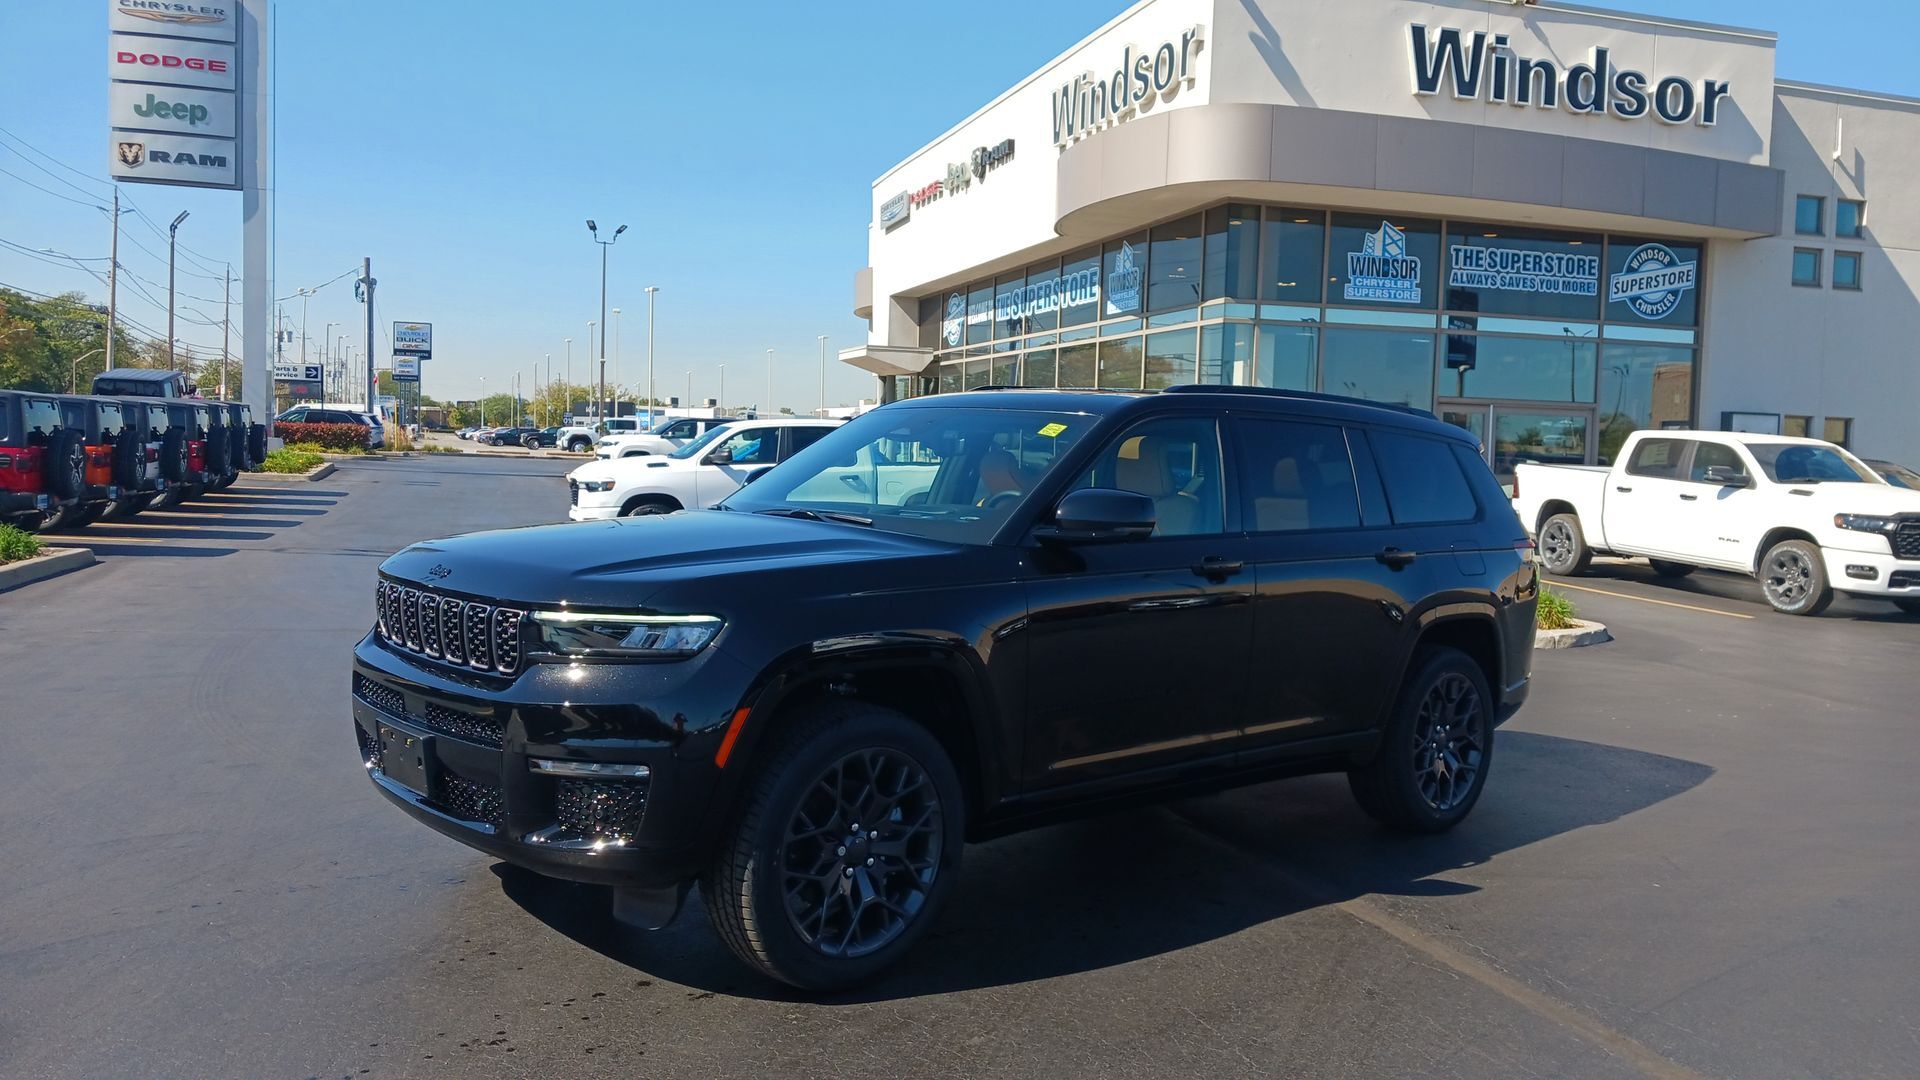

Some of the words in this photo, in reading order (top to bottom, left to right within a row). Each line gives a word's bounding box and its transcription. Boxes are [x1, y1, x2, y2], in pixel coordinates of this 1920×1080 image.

[119, 0, 225, 15] CHRYSLER
[117, 51, 227, 73] DODGE
[1051, 24, 1205, 147] Windsor
[1408, 23, 1731, 127] Windsor
[133, 93, 208, 125] Jeep
[149, 150, 227, 168] RAM
[1350, 255, 1418, 280] WINDSOR
[1452, 248, 1484, 268] THE
[1487, 250, 1597, 277] SUPERSTORE
[1630, 249, 1670, 269] WINDSOR
[1355, 278, 1411, 289] CHRYSLER
[1451, 272, 1497, 287] ALWAYS
[1501, 275, 1536, 290] SAVES
[1539, 278, 1559, 291] YOU
[1562, 280, 1596, 294] MORE!
[1613, 269, 1692, 295] SUPERSTORE
[996, 293, 1011, 320] THE
[1012, 269, 1099, 319] SUPERSTORE
[1347, 287, 1418, 300] SUPERSTORE
[1635, 293, 1676, 315] CHRYSLER
[396, 336, 428, 344] BUICK
